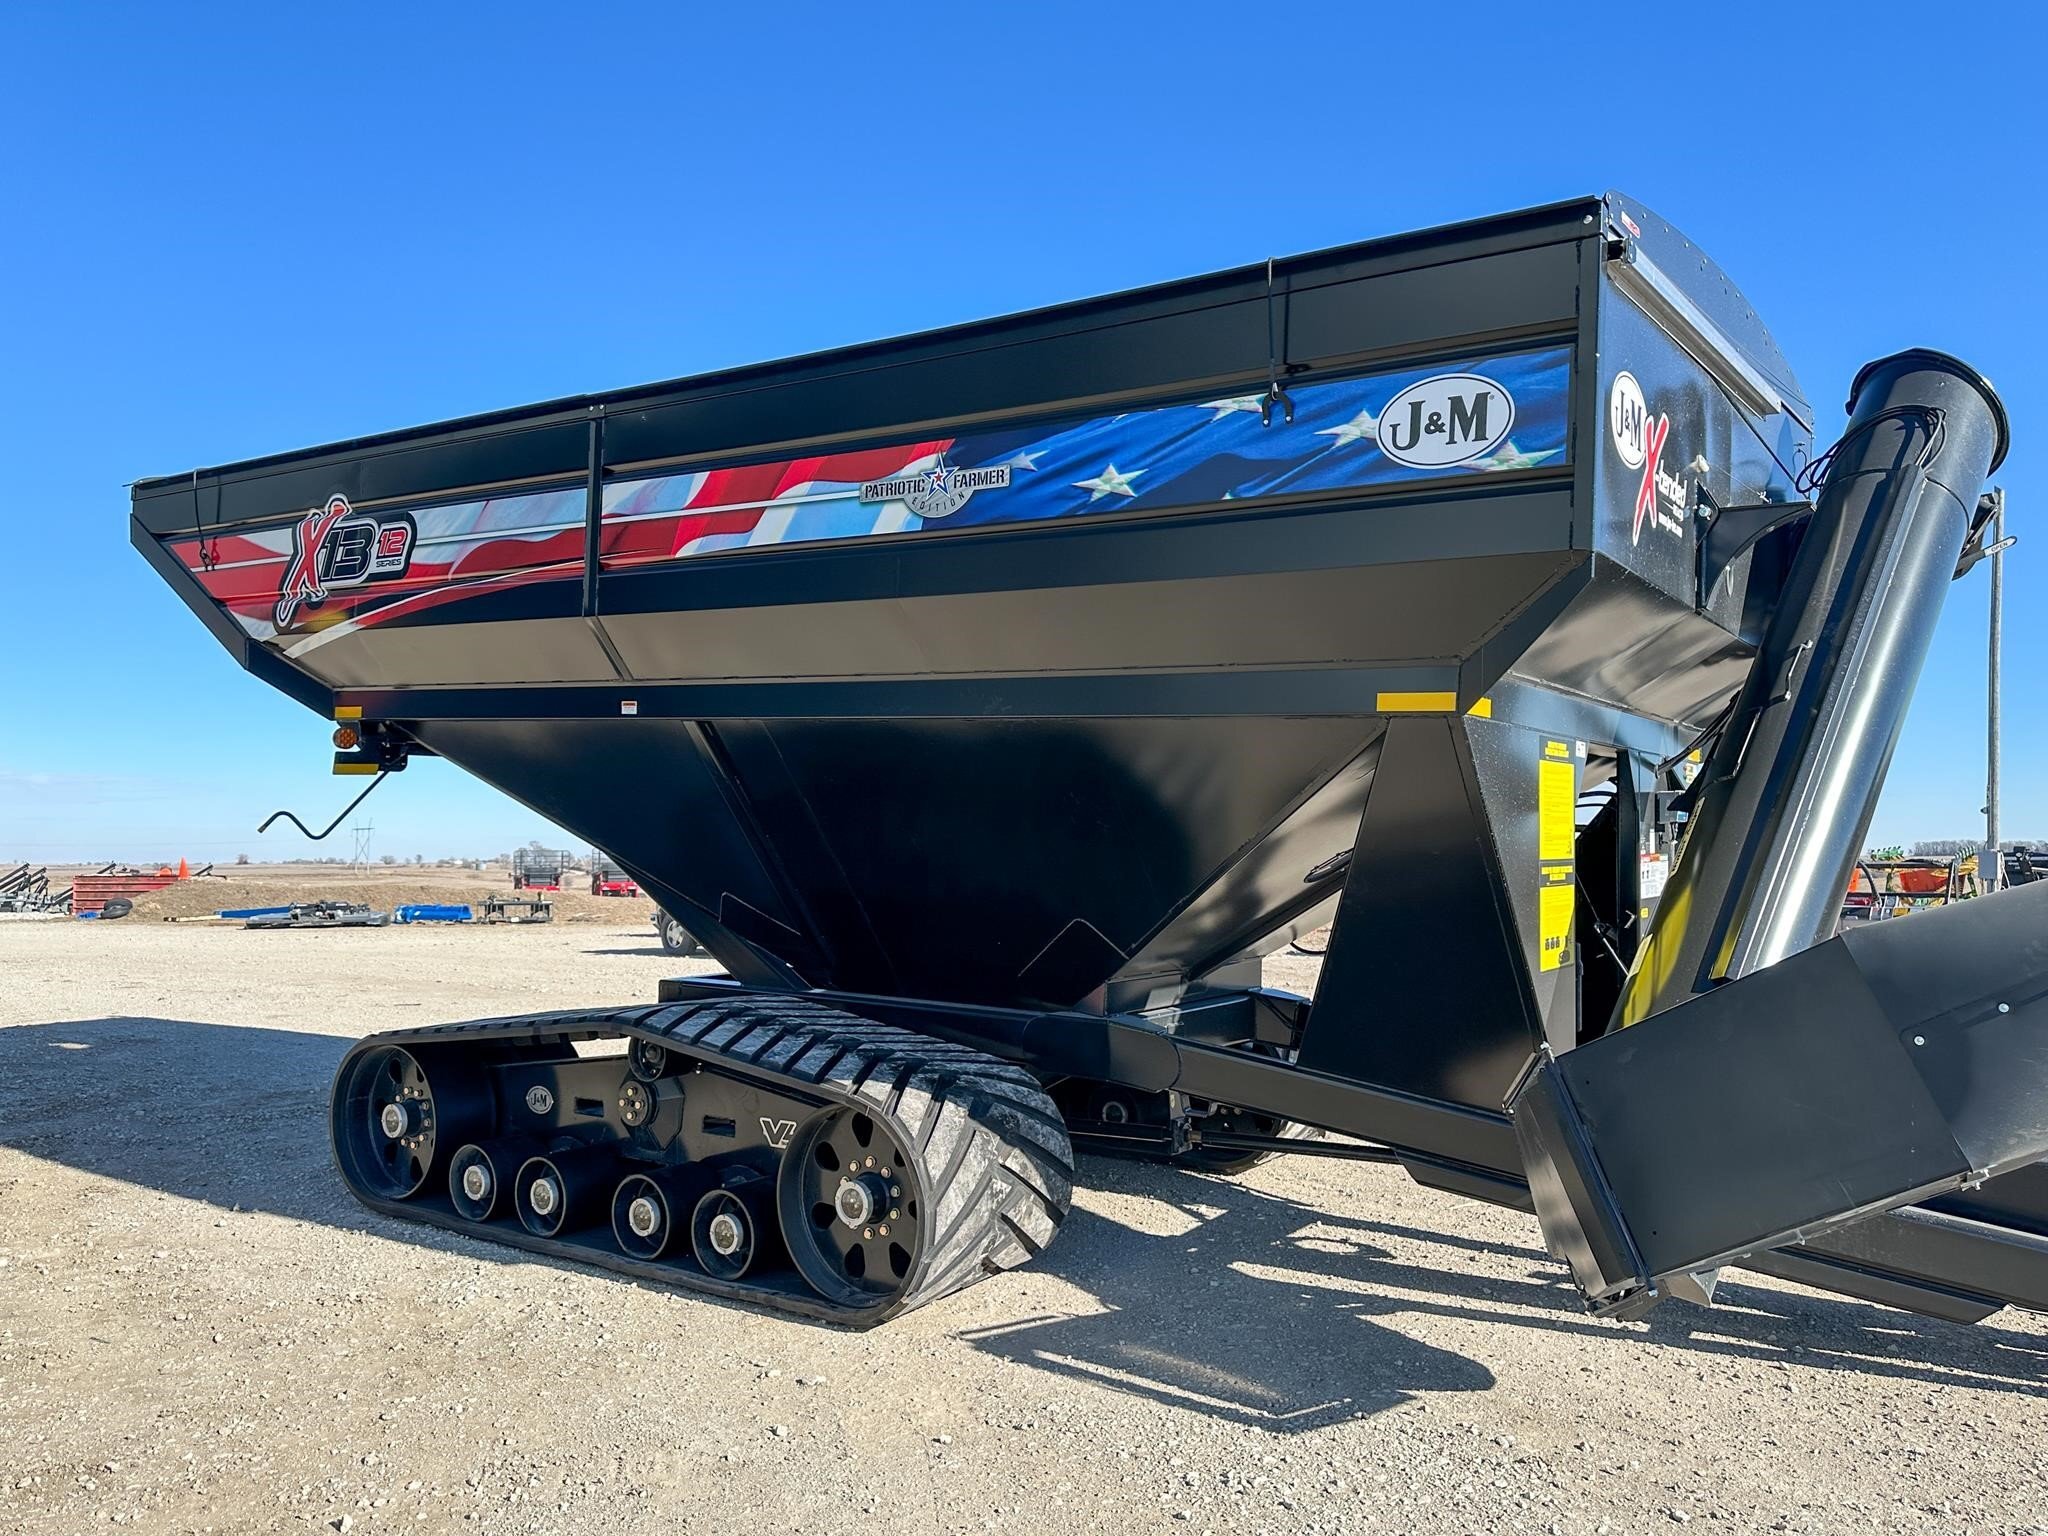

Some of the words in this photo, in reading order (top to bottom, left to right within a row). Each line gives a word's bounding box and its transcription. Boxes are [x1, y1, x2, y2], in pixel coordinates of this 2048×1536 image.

[1389, 391, 1491, 451] J&M
[1615, 390, 1642, 452] J&M
[864, 478, 926, 499] PATRIOTIC
[953, 468, 1006, 489] FARMER
[911, 490, 965, 513] EDITION
[376, 528, 408, 557] 12
[375, 559, 402, 568] SERIES
[530, 1092, 548, 1108] J&M
